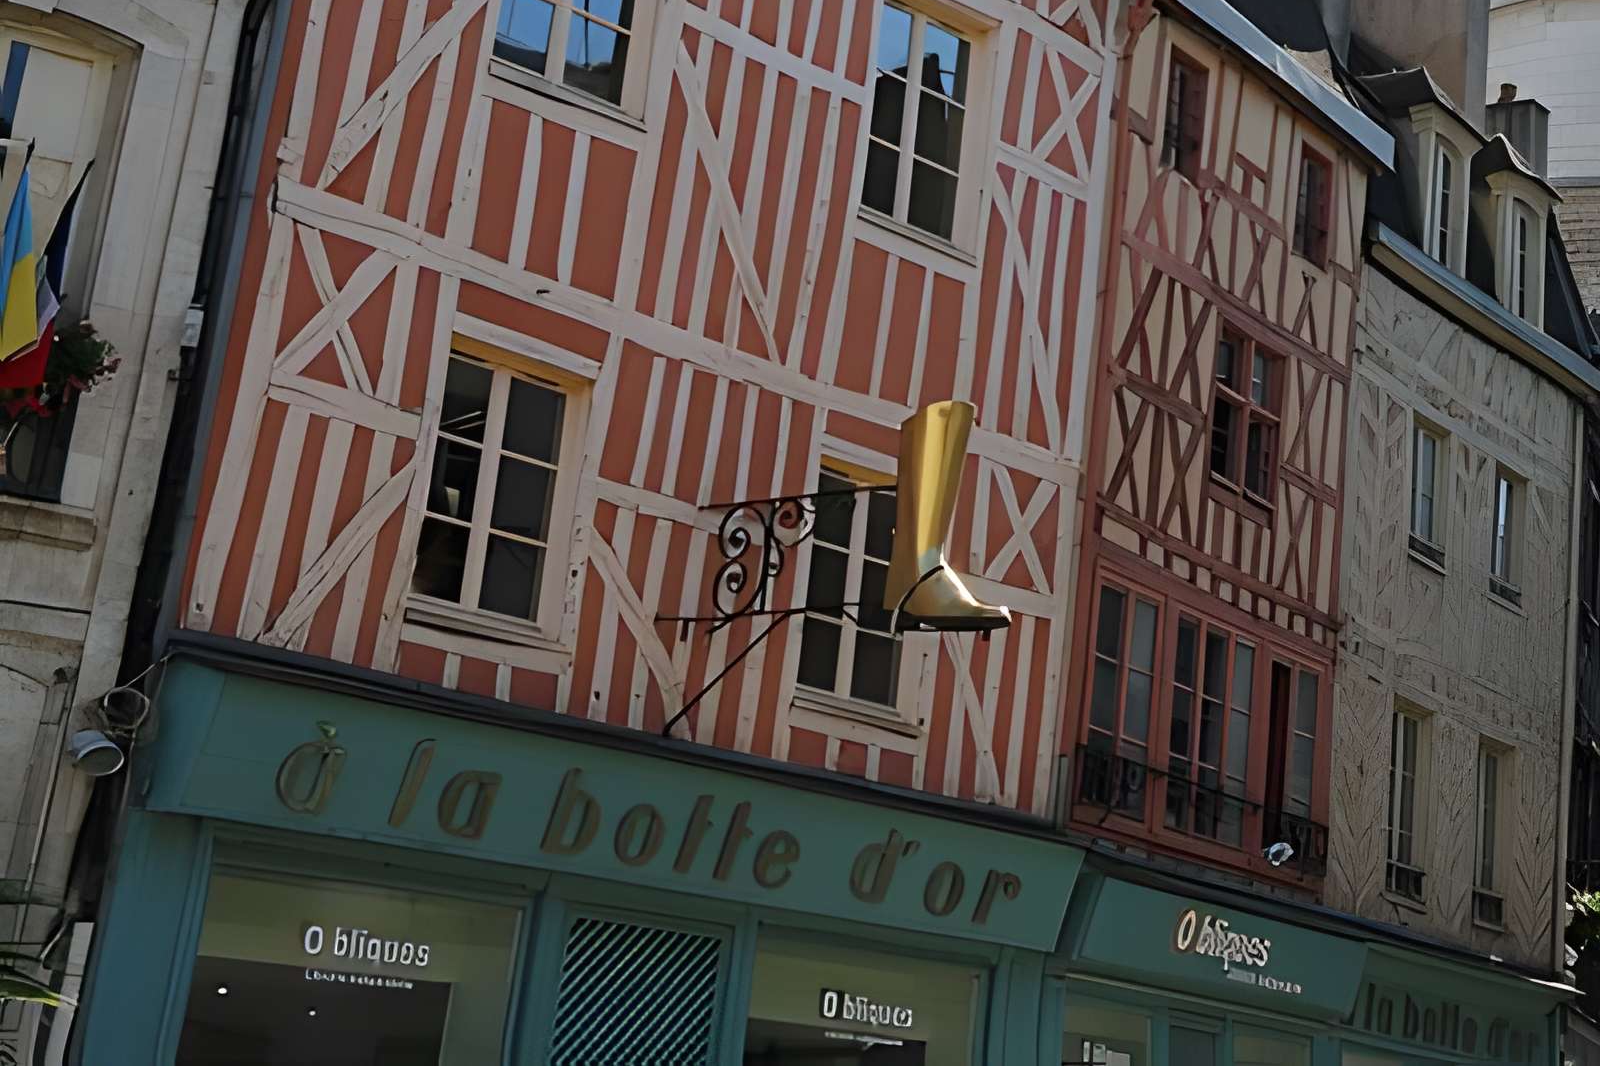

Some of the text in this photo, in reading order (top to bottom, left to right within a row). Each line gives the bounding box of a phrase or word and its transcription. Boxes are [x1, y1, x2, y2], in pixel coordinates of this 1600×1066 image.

[387, 738, 503, 839] la
[539, 767, 801, 889] botte
[848, 828, 1022, 924] d'or
